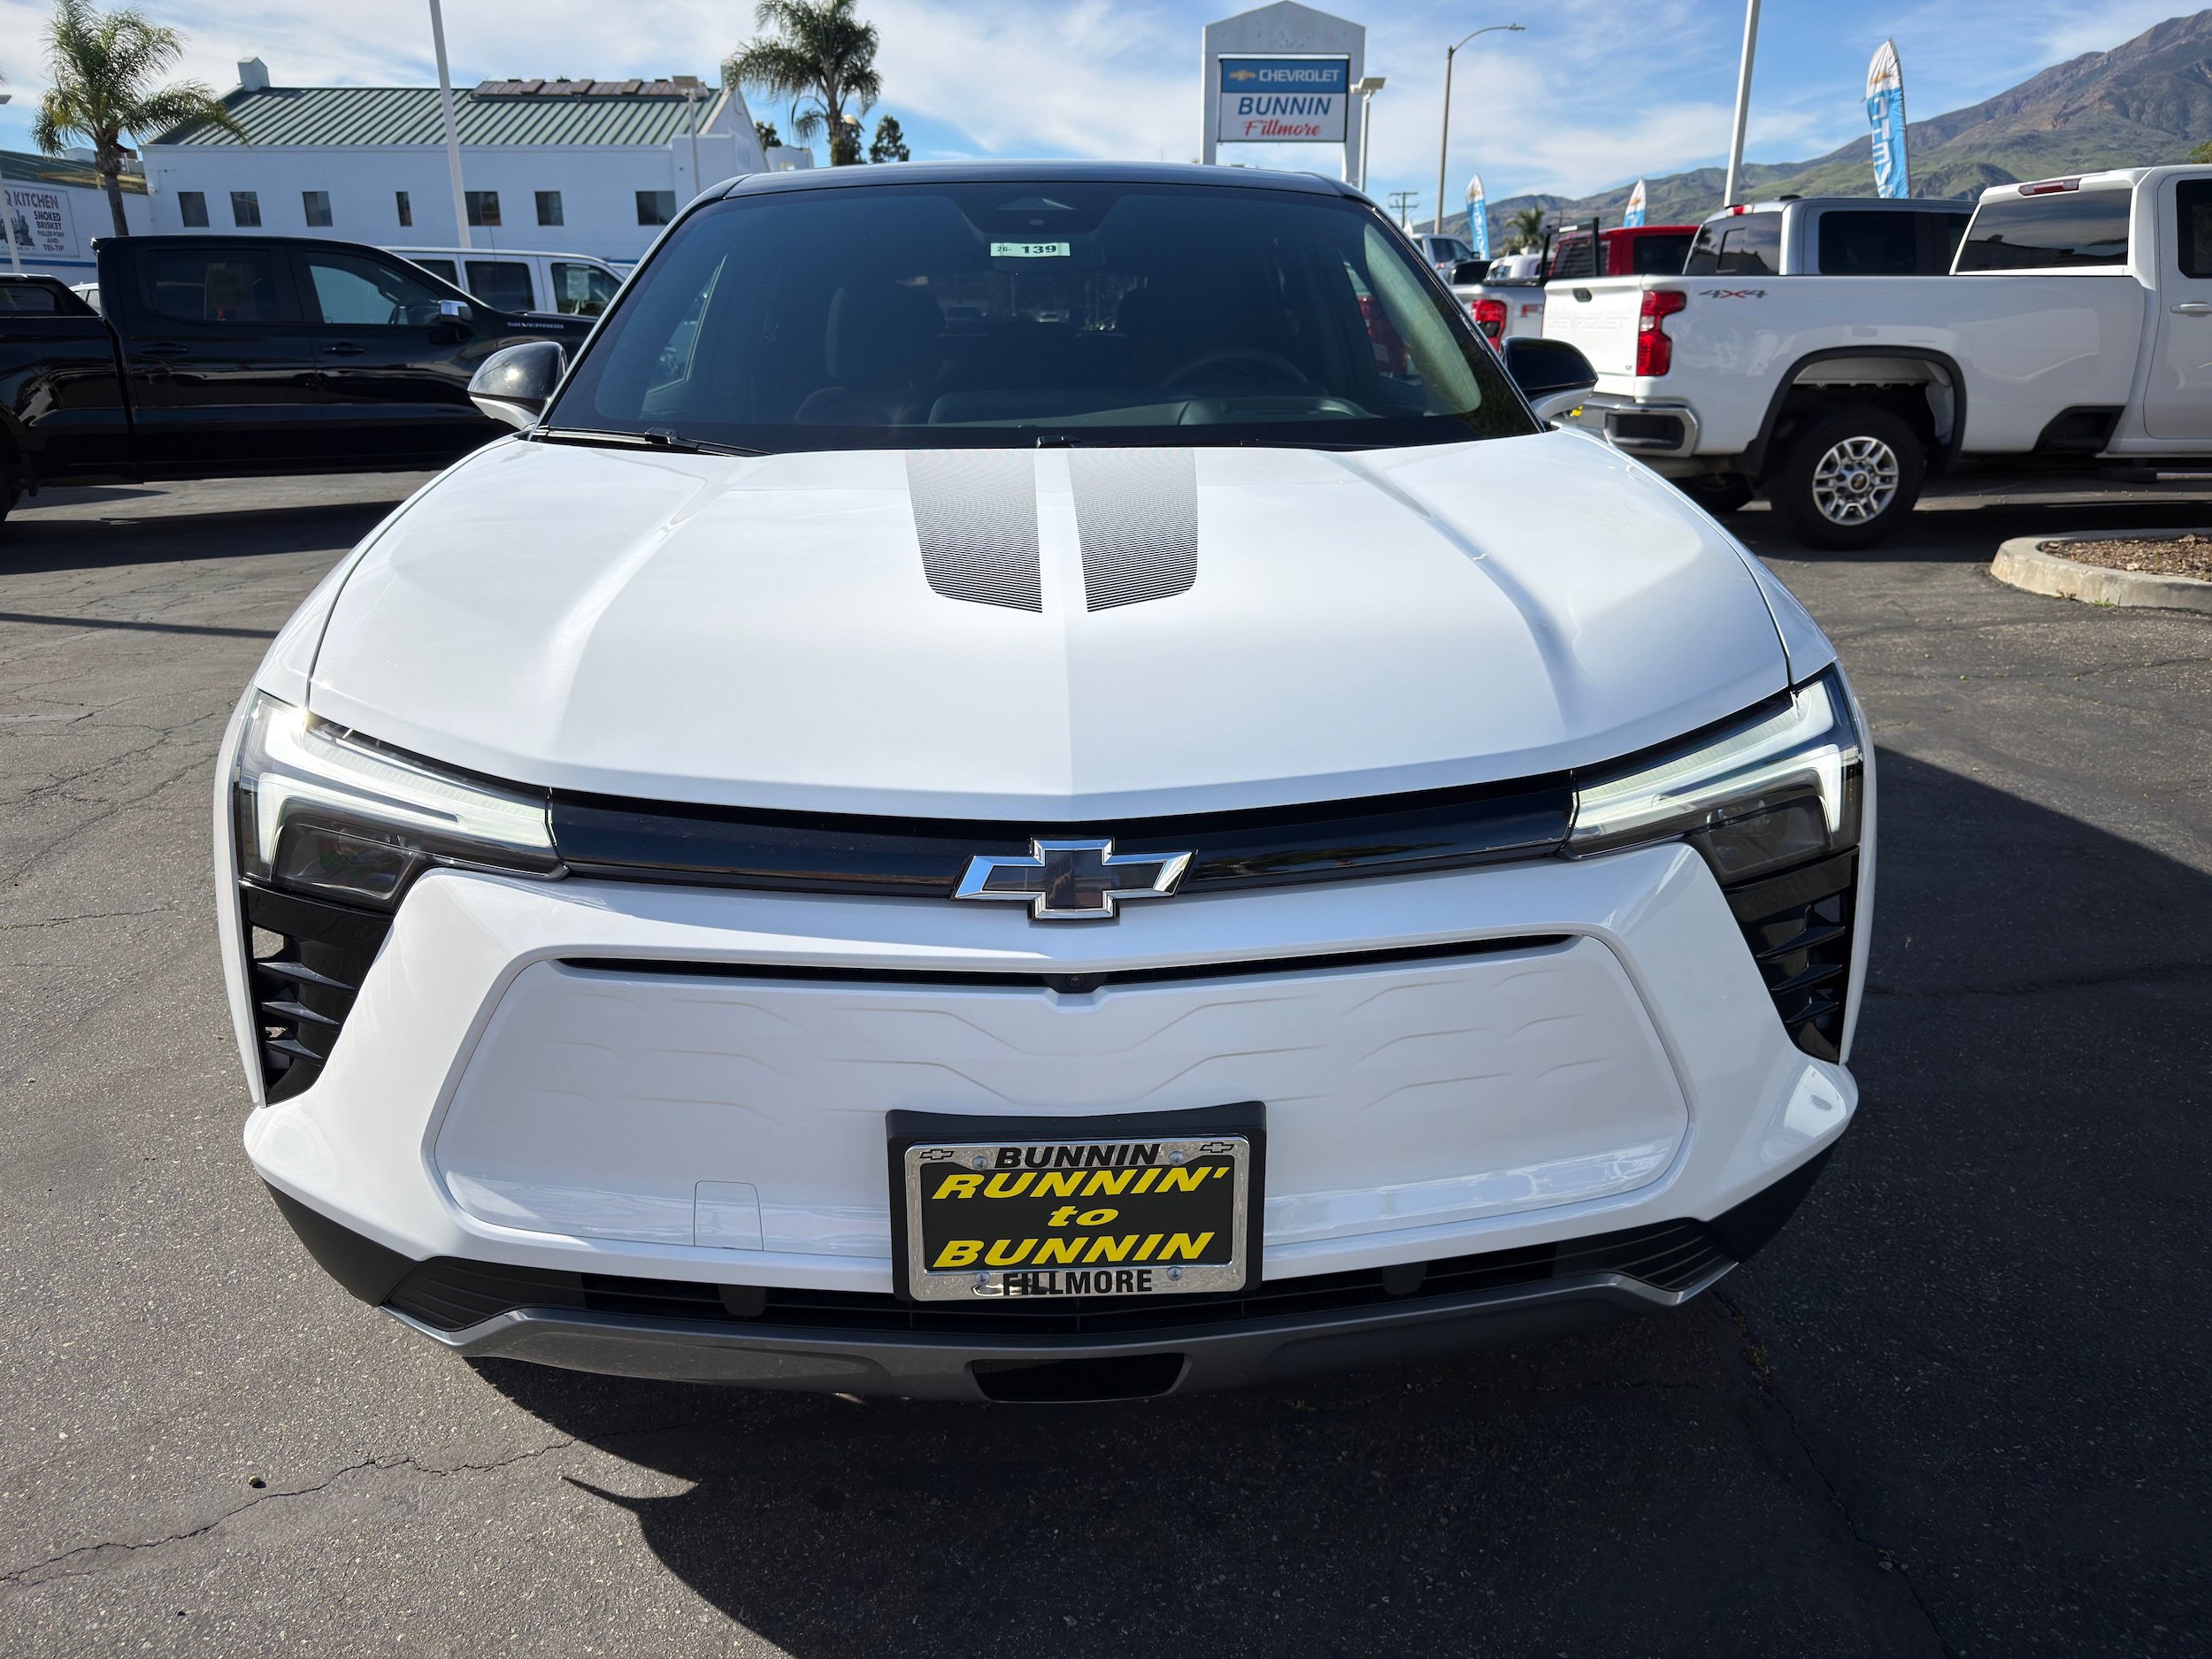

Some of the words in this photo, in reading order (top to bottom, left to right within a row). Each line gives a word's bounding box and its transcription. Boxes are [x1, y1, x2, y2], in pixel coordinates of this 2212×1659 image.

[1259, 69, 1340, 81] CHEVROLET
[1238, 96, 1332, 115] BUNNIN
[1242, 119, 1322, 136] Fillmore
[13, 190, 59, 210] KITCHEN
[34, 211, 61, 221] SMOKED
[36, 220, 62, 230] BRISKET
[1022, 245, 1056, 254] 139
[995, 1144, 1160, 1169] BUNNIN
[931, 1166, 1231, 1200] RUNNIN'
[1047, 1205, 1118, 1226] to
[932, 1232, 1215, 1268] BUNNIN
[1002, 1270, 1153, 1295] FILLMORE
